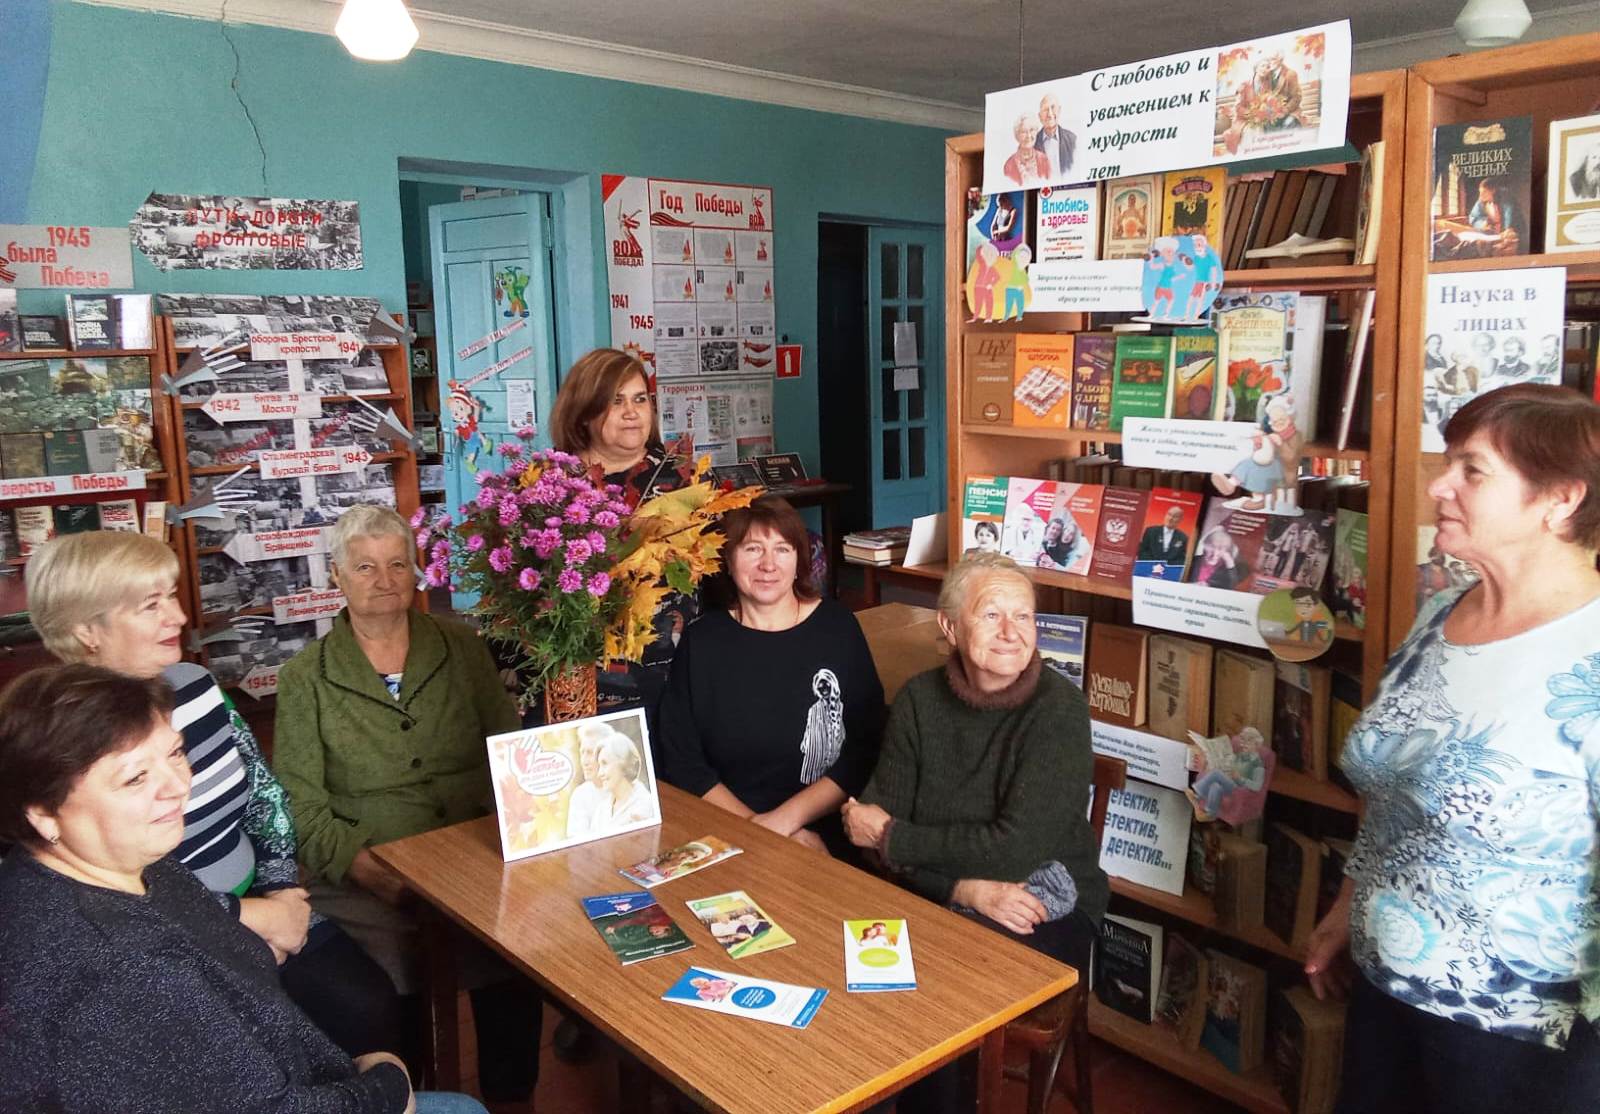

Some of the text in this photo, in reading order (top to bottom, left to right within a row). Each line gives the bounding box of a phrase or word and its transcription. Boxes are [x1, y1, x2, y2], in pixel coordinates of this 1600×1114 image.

[1091, 56, 1210, 92] С любовью и
[1087, 88, 1211, 127] уважением к
[1088, 125, 1178, 152] мудрости
[1452, 148, 1513, 166] ВЕЛИКИХ
[1087, 163, 1121, 180] лет
[1456, 162, 1510, 178] УЧЕНЫХ
[660, 190, 743, 217] Год Победы
[1041, 197, 1089, 214] Влюбись
[1048, 214, 1089, 229] ЗДОРОВЬЕ!
[47, 226, 91, 248] 1945
[196, 230, 307, 249] ФРОНТОВЫЕ
[7, 241, 57, 263] была
[614, 256, 644, 268] ПОБЕДА!
[41, 265, 110, 287] Победа
[611, 294, 629, 309] 1941
[1440, 285, 1537, 308] Наука в
[630, 315, 654, 330] 1945
[1453, 317, 1527, 332] лицах
[251, 333, 337, 345] оборона Брестской
[280, 345, 320, 354] крепости
[338, 341, 360, 353] 1941
[1028, 353, 1060, 361] ШТОПКА
[662, 384, 706, 394] Терроризм
[210, 399, 241, 413] 1942
[261, 404, 297, 414] Москву
[262, 449, 336, 461] Сталинградская
[343, 452, 369, 464] 1943
[272, 465, 310, 477] Курская
[1, 474, 129, 498] версты Победы
[255, 528, 321, 542] освобождение
[310, 590, 344, 602] блокад
[246, 674, 278, 689] 1945
[1110, 789, 1161, 819] етектив,
[1104, 811, 1160, 844] етектив,
[1106, 835, 1173, 871] детектив...
